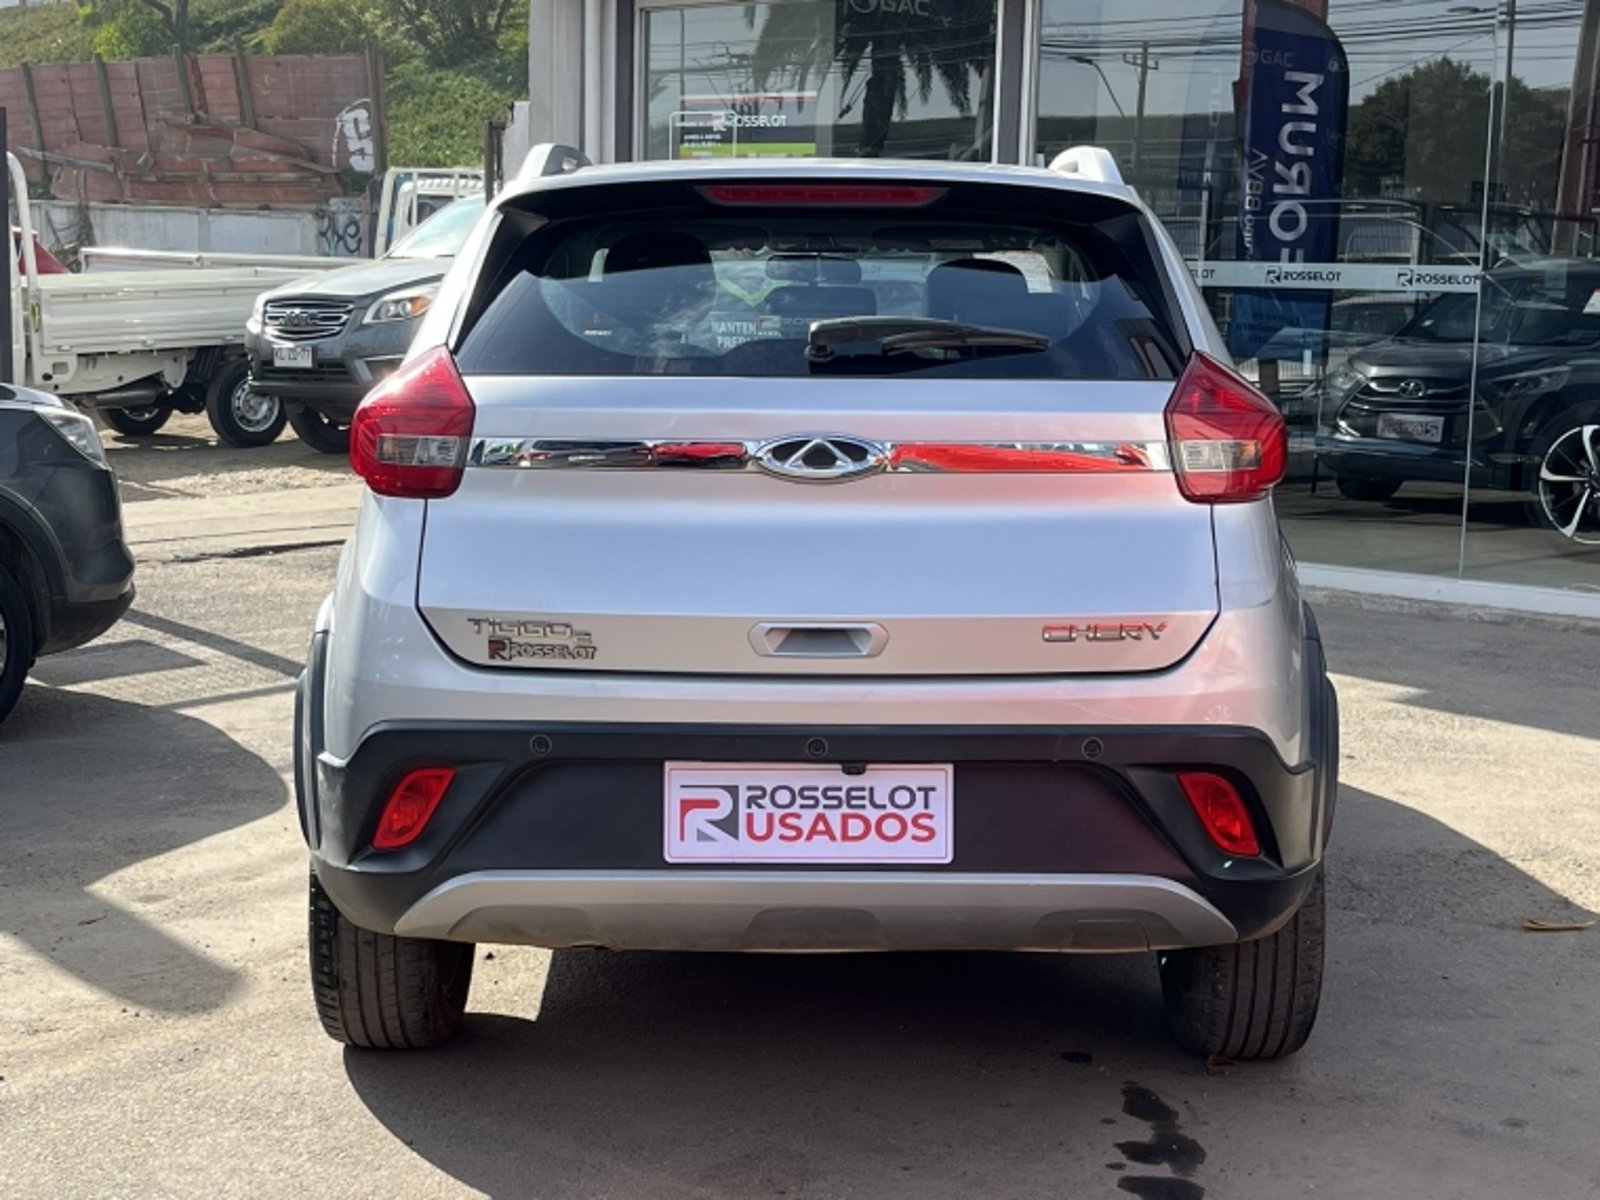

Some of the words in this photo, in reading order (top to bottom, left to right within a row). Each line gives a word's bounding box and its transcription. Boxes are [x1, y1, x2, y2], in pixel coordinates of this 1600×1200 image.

[1283, 271, 1342, 282] ROSSELOT
[1415, 273, 1479, 286] ROSSELOT
[1042, 621, 1168, 643] CHERY
[510, 641, 597, 661] ROSSELOT
[745, 785, 937, 810] ROSSELOT
[745, 812, 936, 843] USADOS
